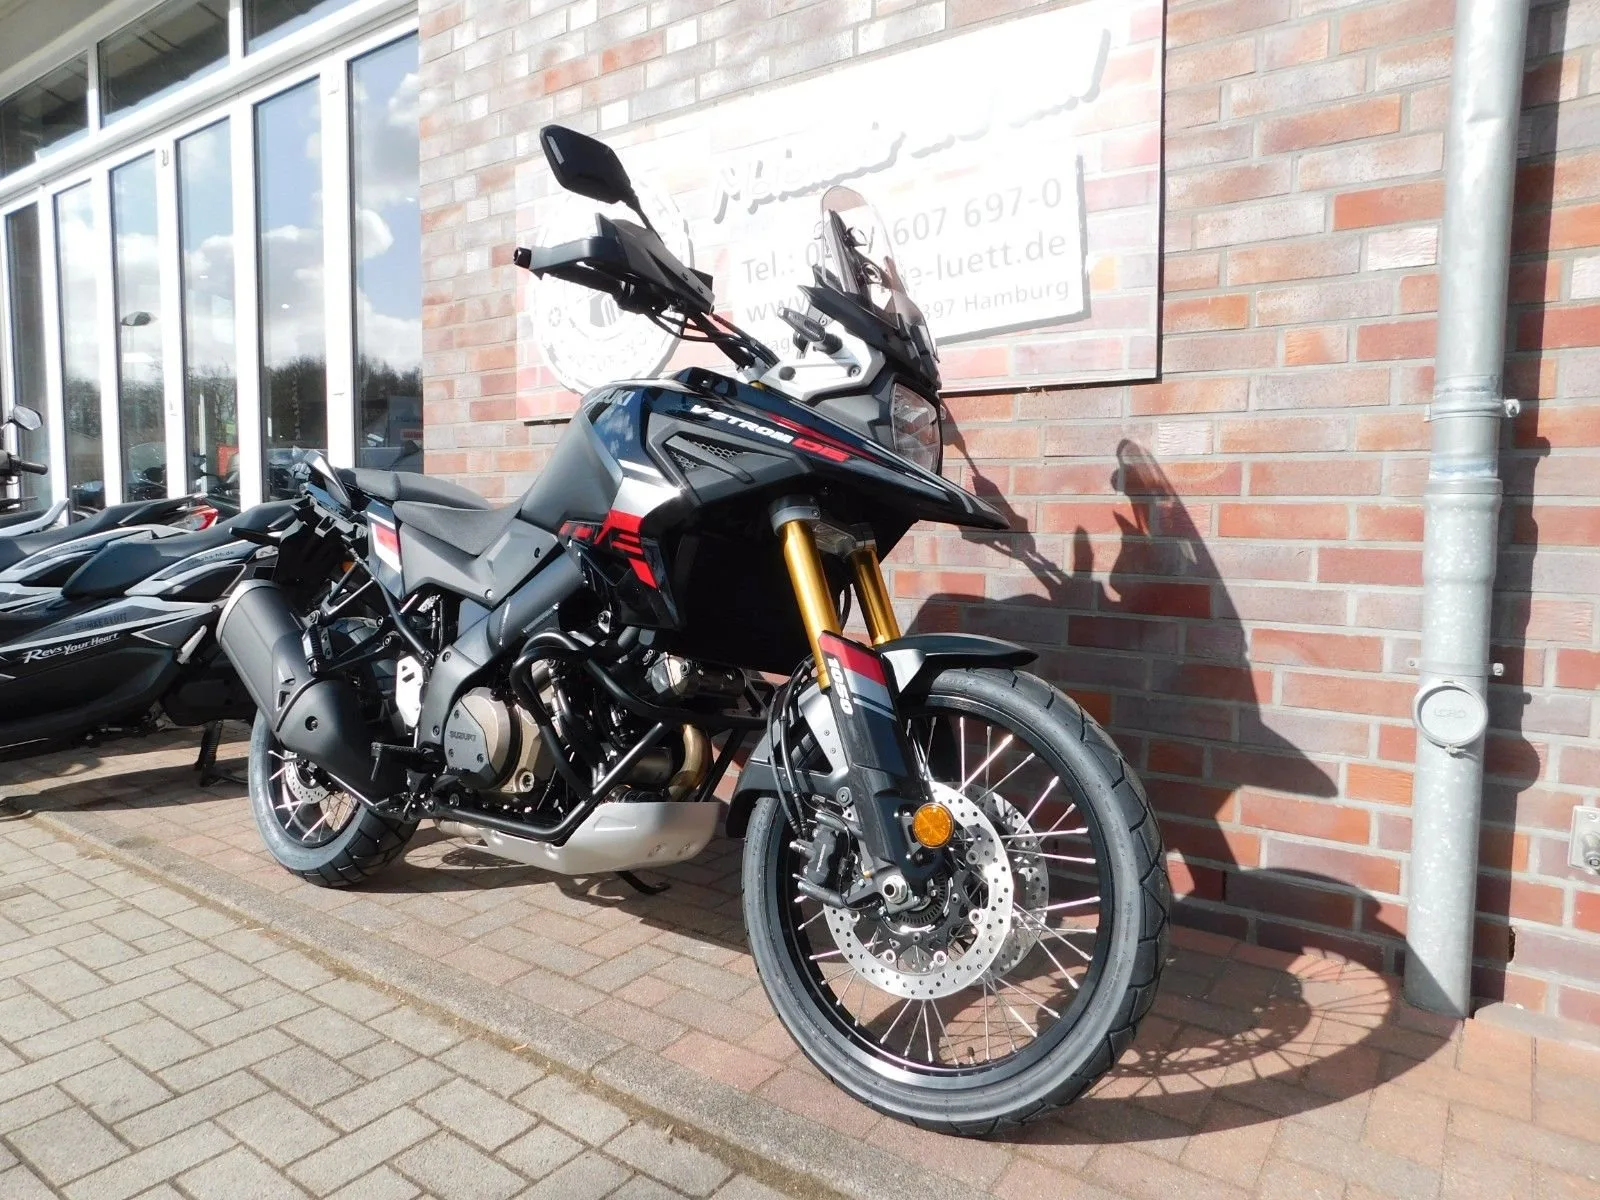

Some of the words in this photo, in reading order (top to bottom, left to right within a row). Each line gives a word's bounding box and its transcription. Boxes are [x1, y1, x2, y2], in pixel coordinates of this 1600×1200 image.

[741, 250, 794, 284] Tel.:
[893, 206, 947, 246] 607
[964, 177, 1062, 228] 697-0
[964, 280, 1069, 313] Hamburg
[690, 404, 795, 443] V-STROM
[22, 646, 62, 664] Revs
[64, 641, 91, 656] Your
[91, 632, 119, 646] Heart
[827, 657, 853, 715] 1050
[449, 731, 476, 741] SUZUKI
